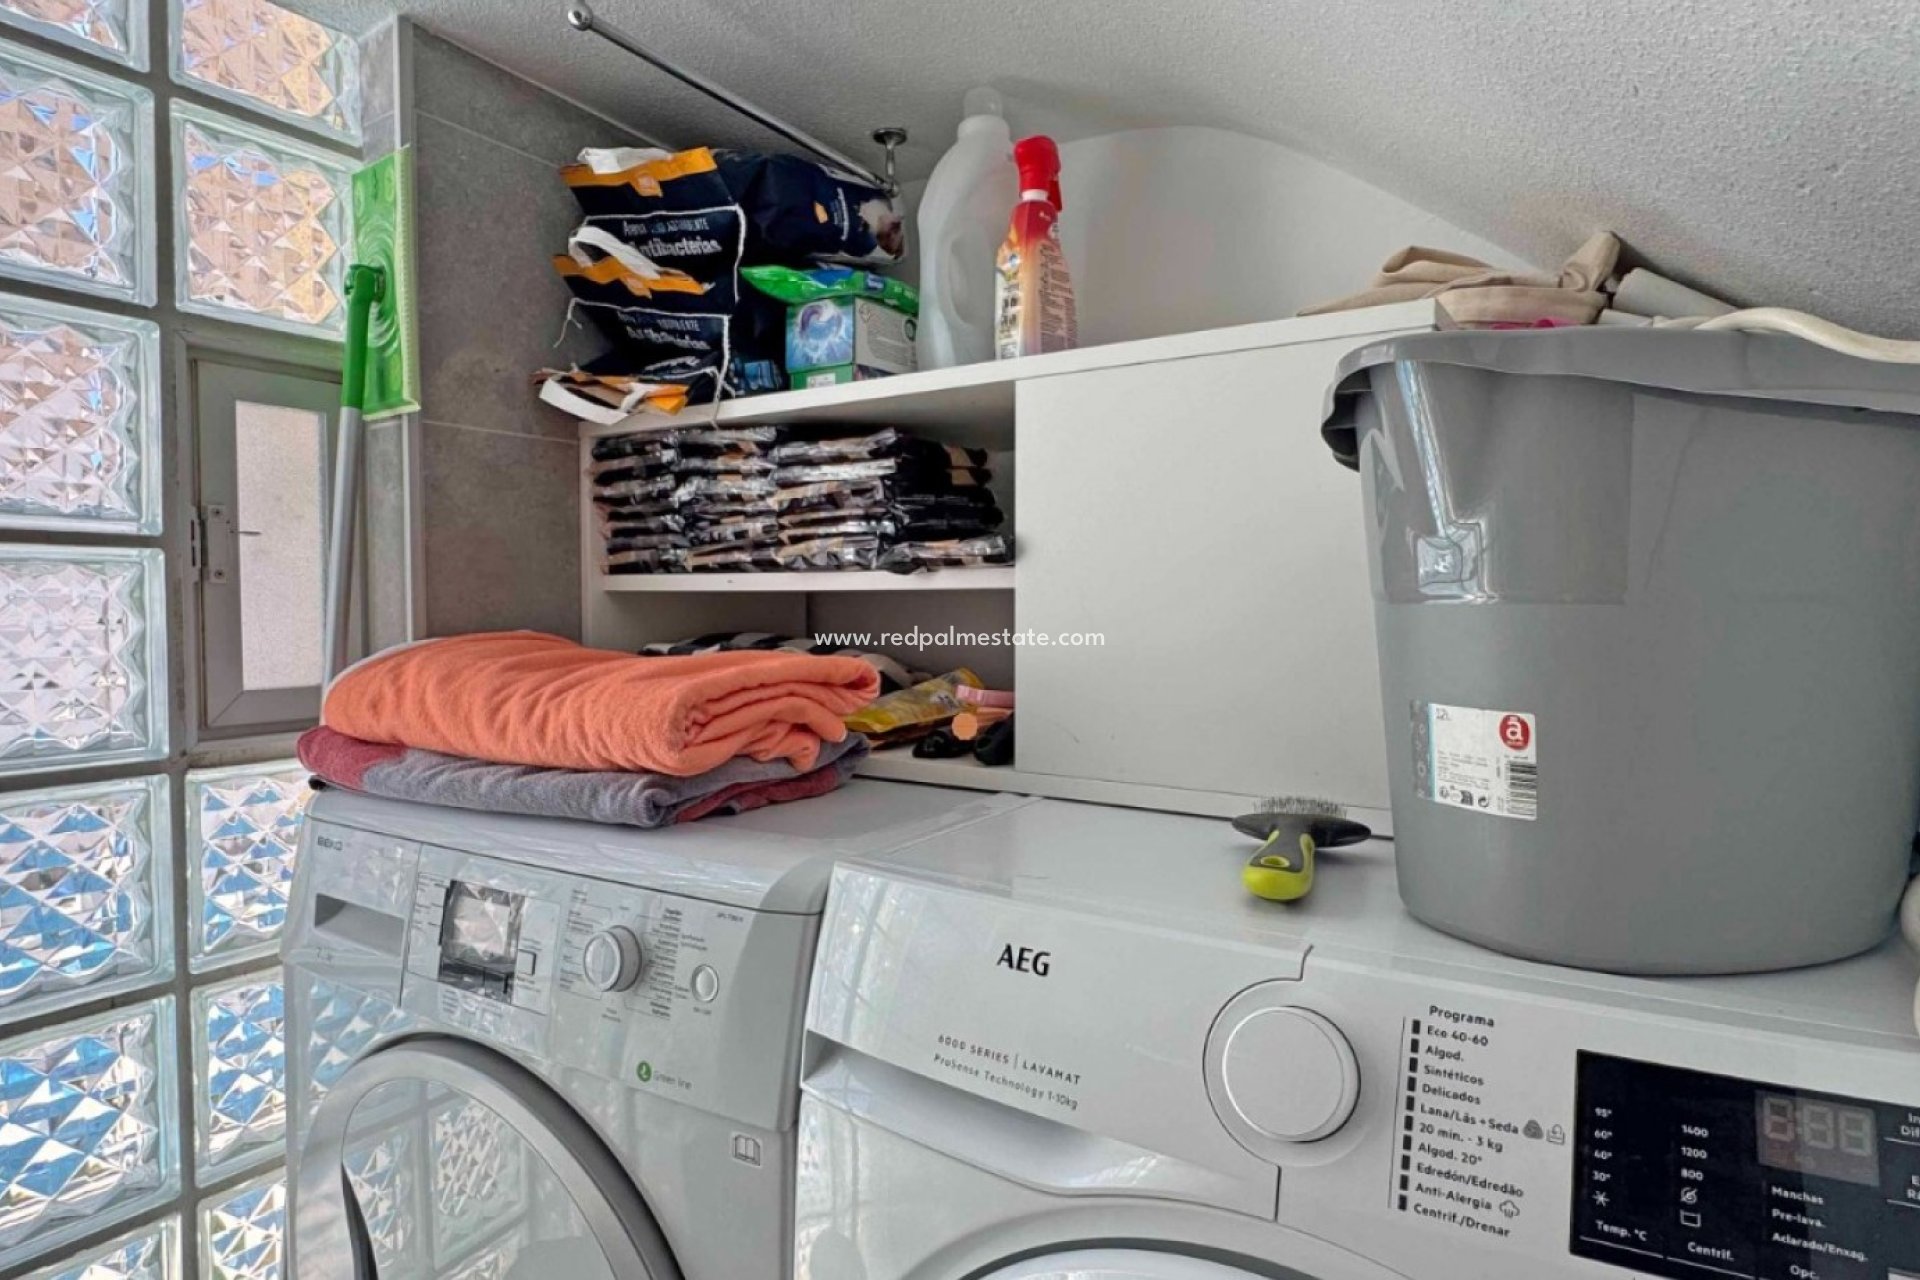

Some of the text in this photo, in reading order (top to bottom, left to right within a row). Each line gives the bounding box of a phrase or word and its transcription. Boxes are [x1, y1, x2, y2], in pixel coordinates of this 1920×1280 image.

[997, 943, 1051, 977] AEG
[1429, 1005, 1494, 1027] Programa
[1428, 1025, 1489, 1046] Eco 40-60
[938, 1034, 1081, 1085] 6000 SERIES LAVAMAT
[1426, 1045, 1464, 1062] Algod.
[934, 1053, 979, 1077] ProSense
[985, 1070, 1045, 1099] Technology
[1424, 1065, 1484, 1086] Sintéticos
[1422, 1083, 1481, 1105] Delicados
[1488, 1118, 1519, 1134] Seda
[1681, 1124, 1709, 1138] 1400
[1419, 1122, 1435, 1135] 20
[1487, 1138, 1503, 1153] kg
[1418, 1142, 1458, 1161] Algod.
[1681, 1146, 1708, 1159] 1200
[1681, 1168, 1704, 1181] 800
[1415, 1183, 1492, 1210] Anti-Alergia
[1771, 1186, 1824, 1205] Manchas
[1413, 1203, 1511, 1237] Centrif./Drenar
[1596, 1219, 1631, 1238] Temp.
[1772, 1208, 1826, 1228] Pre-lava.
